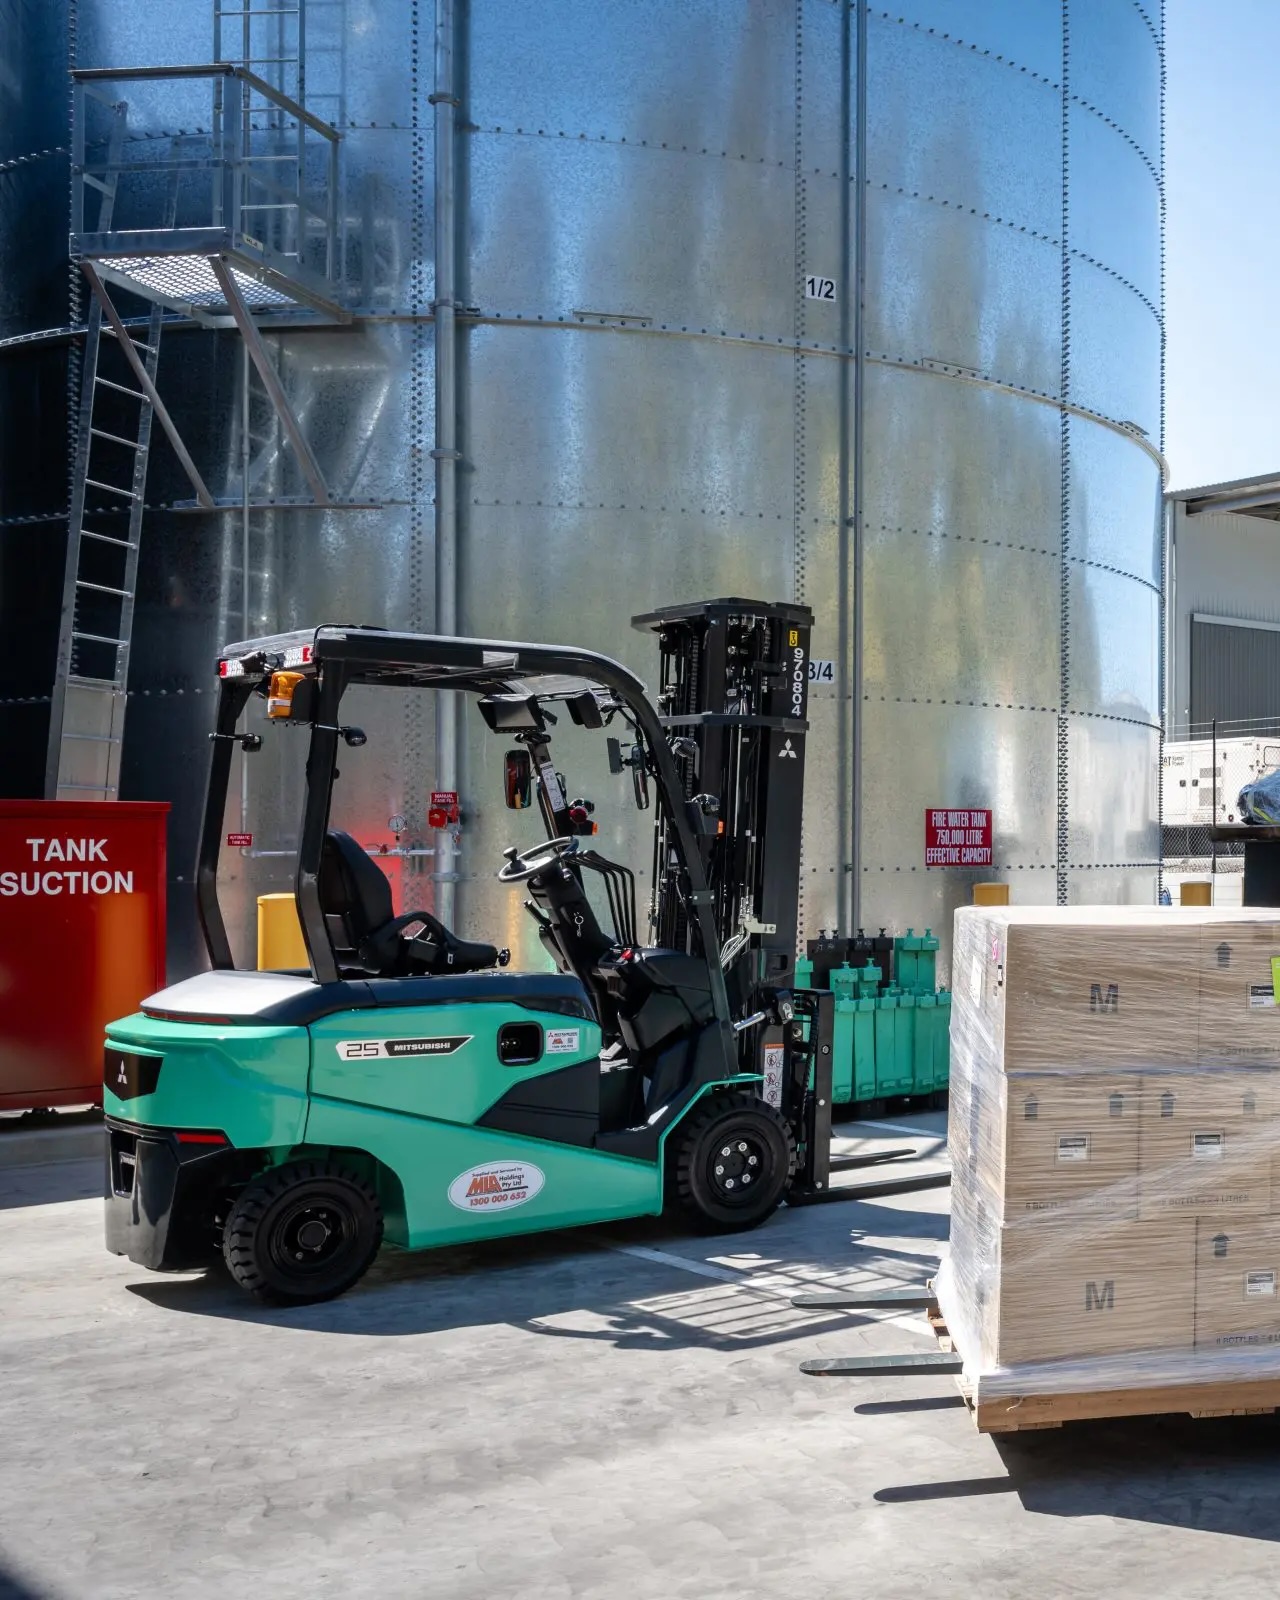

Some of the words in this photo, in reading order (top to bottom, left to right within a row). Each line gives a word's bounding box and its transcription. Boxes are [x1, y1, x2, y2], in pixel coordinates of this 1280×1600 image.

[807, 277, 835, 299] 1/2
[808, 661, 833, 681] 3/4
[791, 647, 804, 717] 970804
[1163, 756, 1171, 767] AT
[931, 811, 947, 828] FIRE
[947, 811, 969, 828] WATER
[970, 812, 987, 828] TANK
[936, 829, 965, 848] 750,000
[965, 829, 984, 845] LITRE
[25, 838, 109, 862] TANK
[926, 847, 960, 863] EFFECTIVE
[961, 847, 992, 863] CAPACITY
[0, 870, 134, 896] SUCTION
[1089, 983, 1119, 1013] M
[346, 1042, 380, 1058] 25
[393, 1041, 451, 1052] MITSUBISHI
[466, 1174, 503, 1196] MIA
[498, 1173, 525, 1182] Holdings
[501, 1181, 512, 1189] Pty
[512, 1179, 522, 1187] Ltd
[470, 1196, 490, 1207] 1300
[491, 1193, 509, 1204] 000
[509, 1190, 527, 1201] 652
[1085, 1279, 1114, 1311] M
